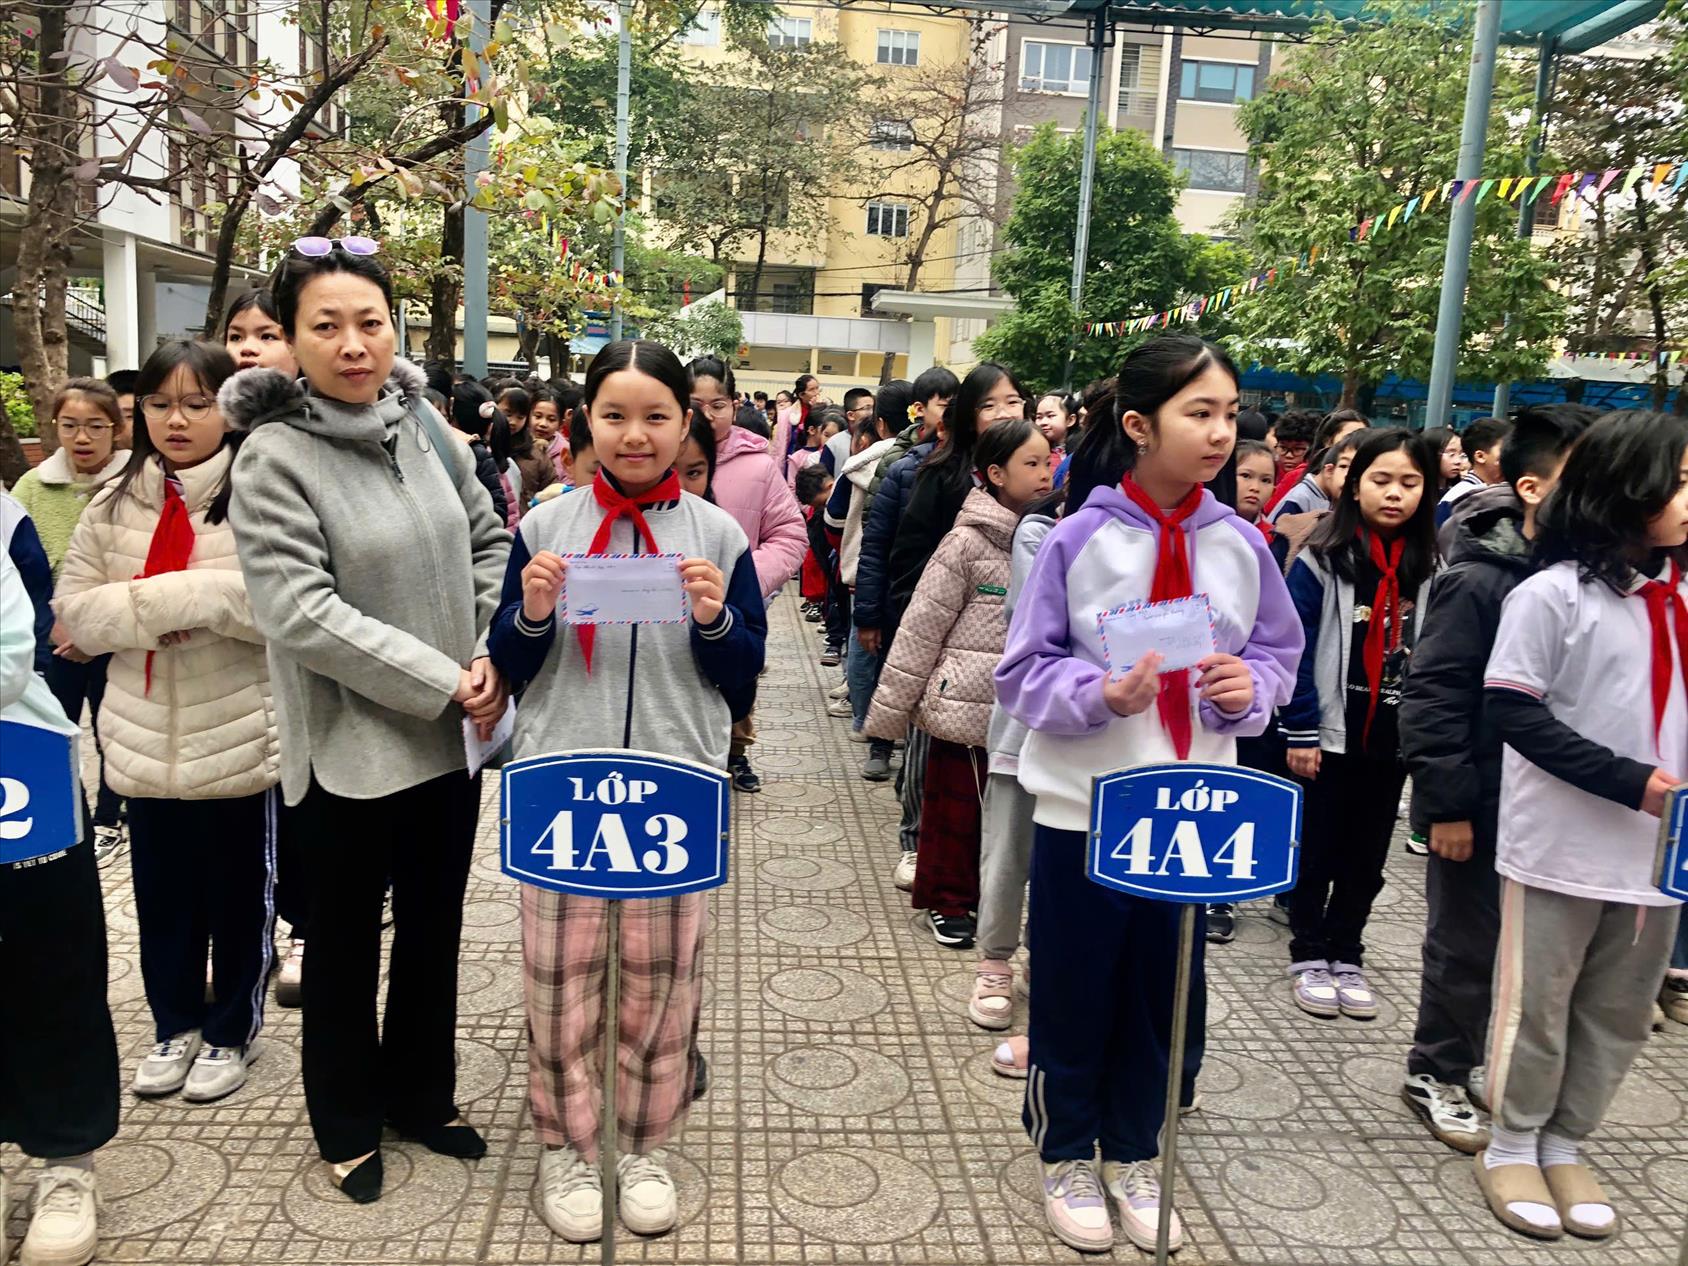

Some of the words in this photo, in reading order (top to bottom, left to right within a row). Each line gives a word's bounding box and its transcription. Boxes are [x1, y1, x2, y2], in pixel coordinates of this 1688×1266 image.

[568, 771, 658, 805] LỚP
[1154, 779, 1239, 812] LỚP
[530, 811, 689, 875] 4A3
[1111, 817, 1258, 879] 4A4
